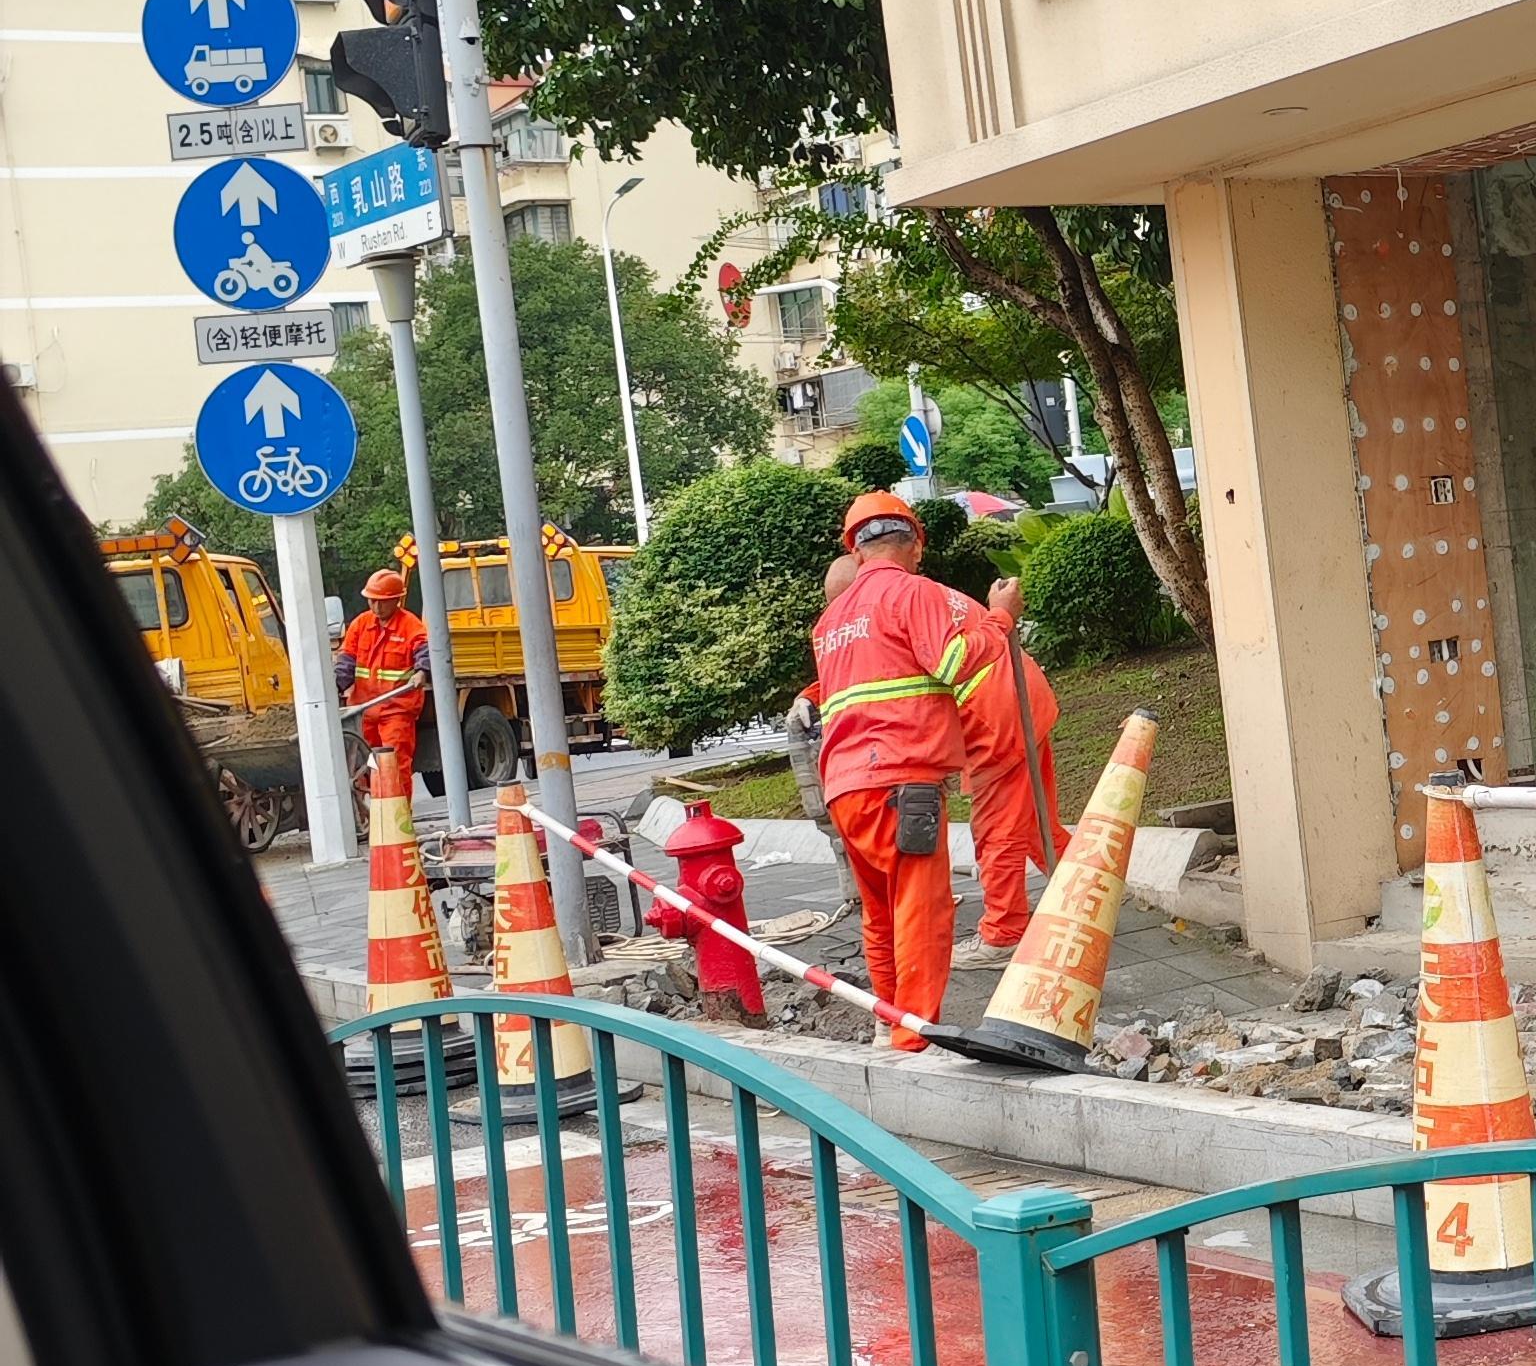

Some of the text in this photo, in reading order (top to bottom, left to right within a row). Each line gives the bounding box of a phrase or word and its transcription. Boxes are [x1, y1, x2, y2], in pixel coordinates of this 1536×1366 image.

[350, 161, 406, 218] 乳山路
[206, 321, 327, 354] (含)轻便摩托
[1072, 997, 1096, 1031] 4
[1435, 1201, 1475, 1257] 4
